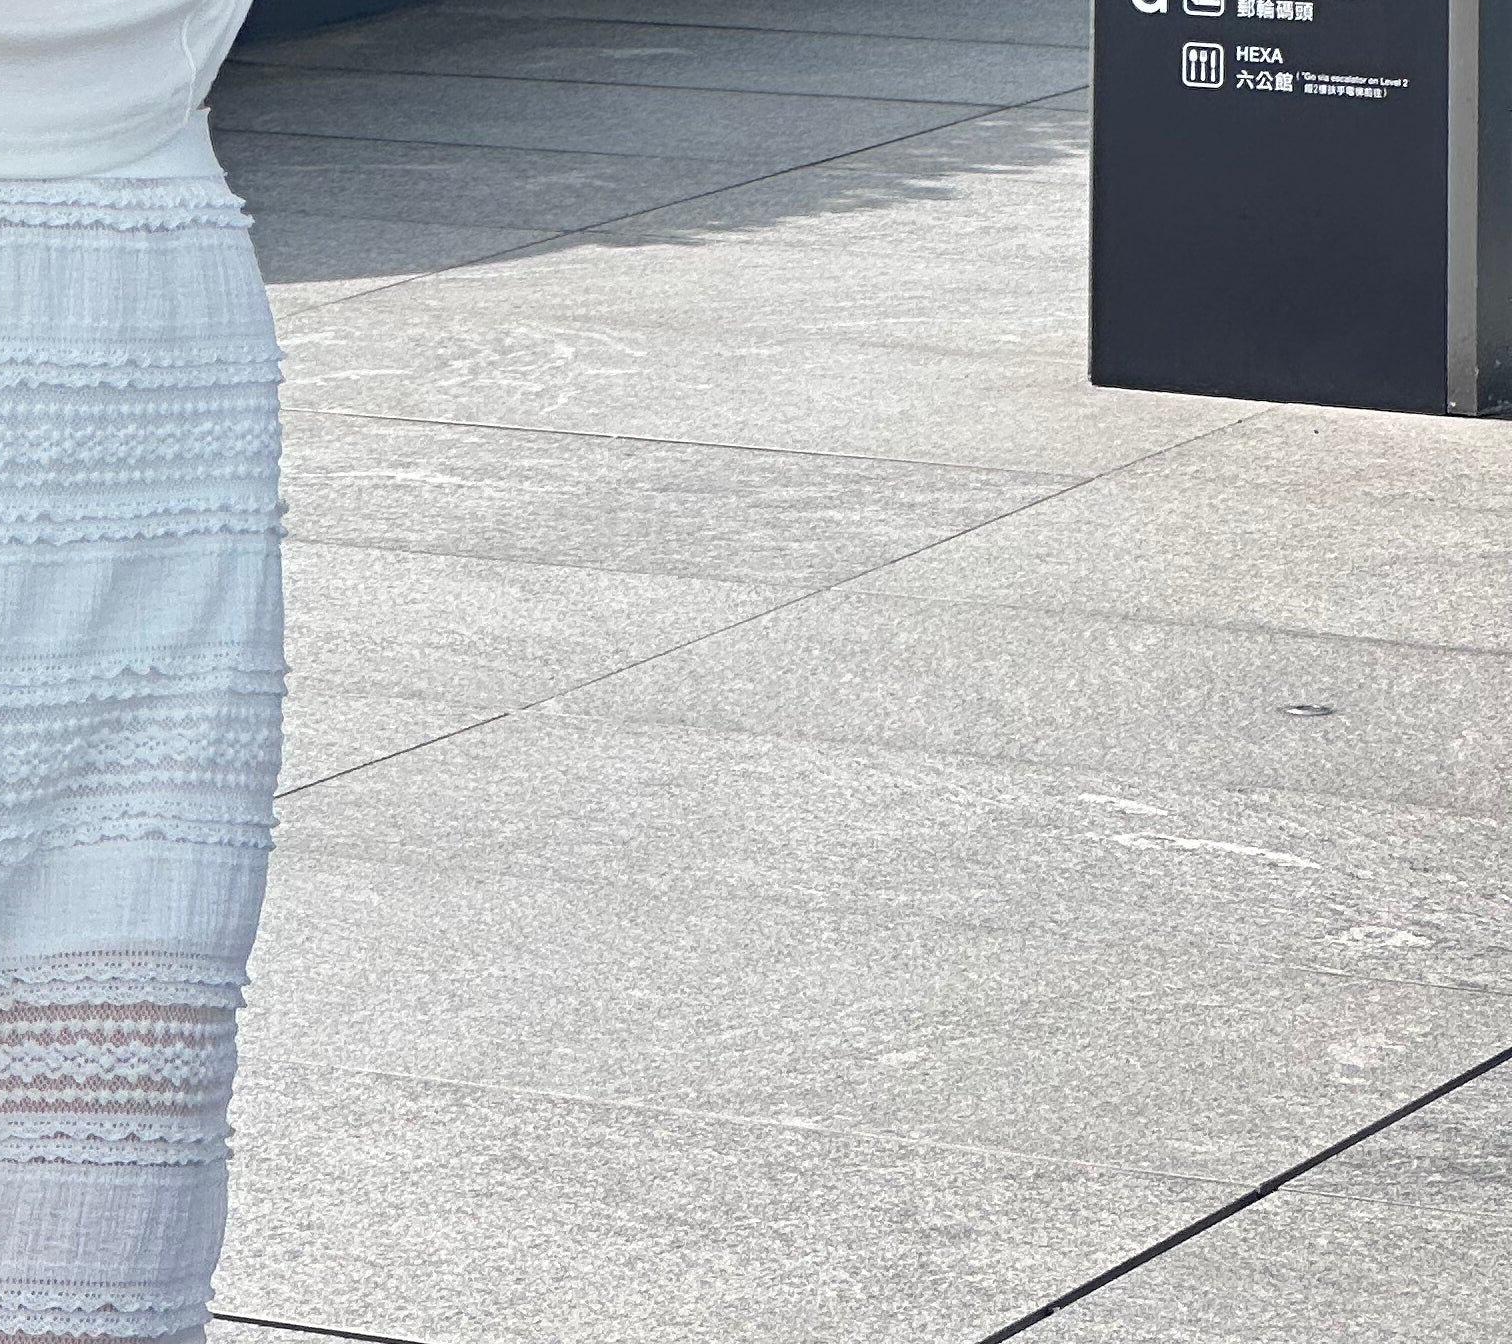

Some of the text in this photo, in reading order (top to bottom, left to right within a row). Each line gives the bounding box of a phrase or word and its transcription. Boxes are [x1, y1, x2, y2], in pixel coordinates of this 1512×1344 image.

[1235, 45, 1284, 64] HEXA
[1235, 69, 1294, 93] 六公館
